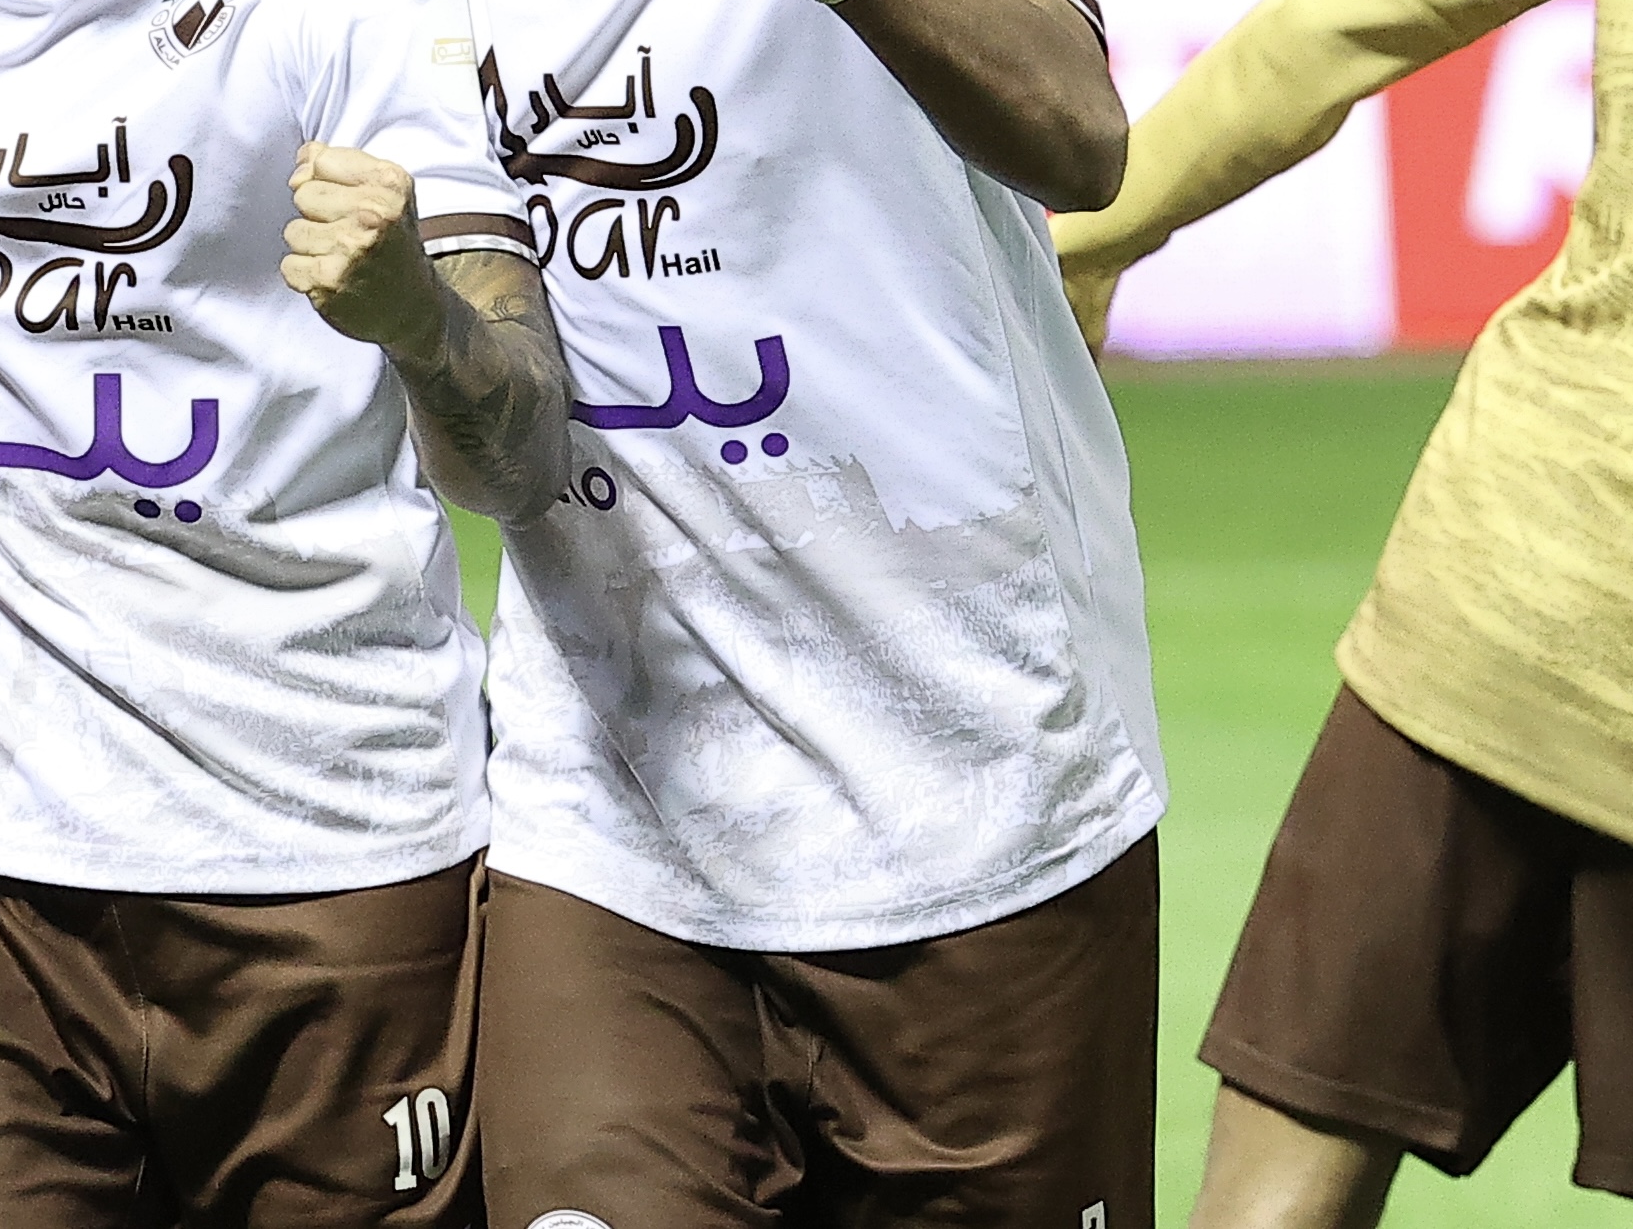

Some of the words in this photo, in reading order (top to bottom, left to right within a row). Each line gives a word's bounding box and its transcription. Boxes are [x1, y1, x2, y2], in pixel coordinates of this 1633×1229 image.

[660, 248, 722, 278] Hail
[113, 314, 173, 334] Hail
[382, 1086, 451, 1192] 10
